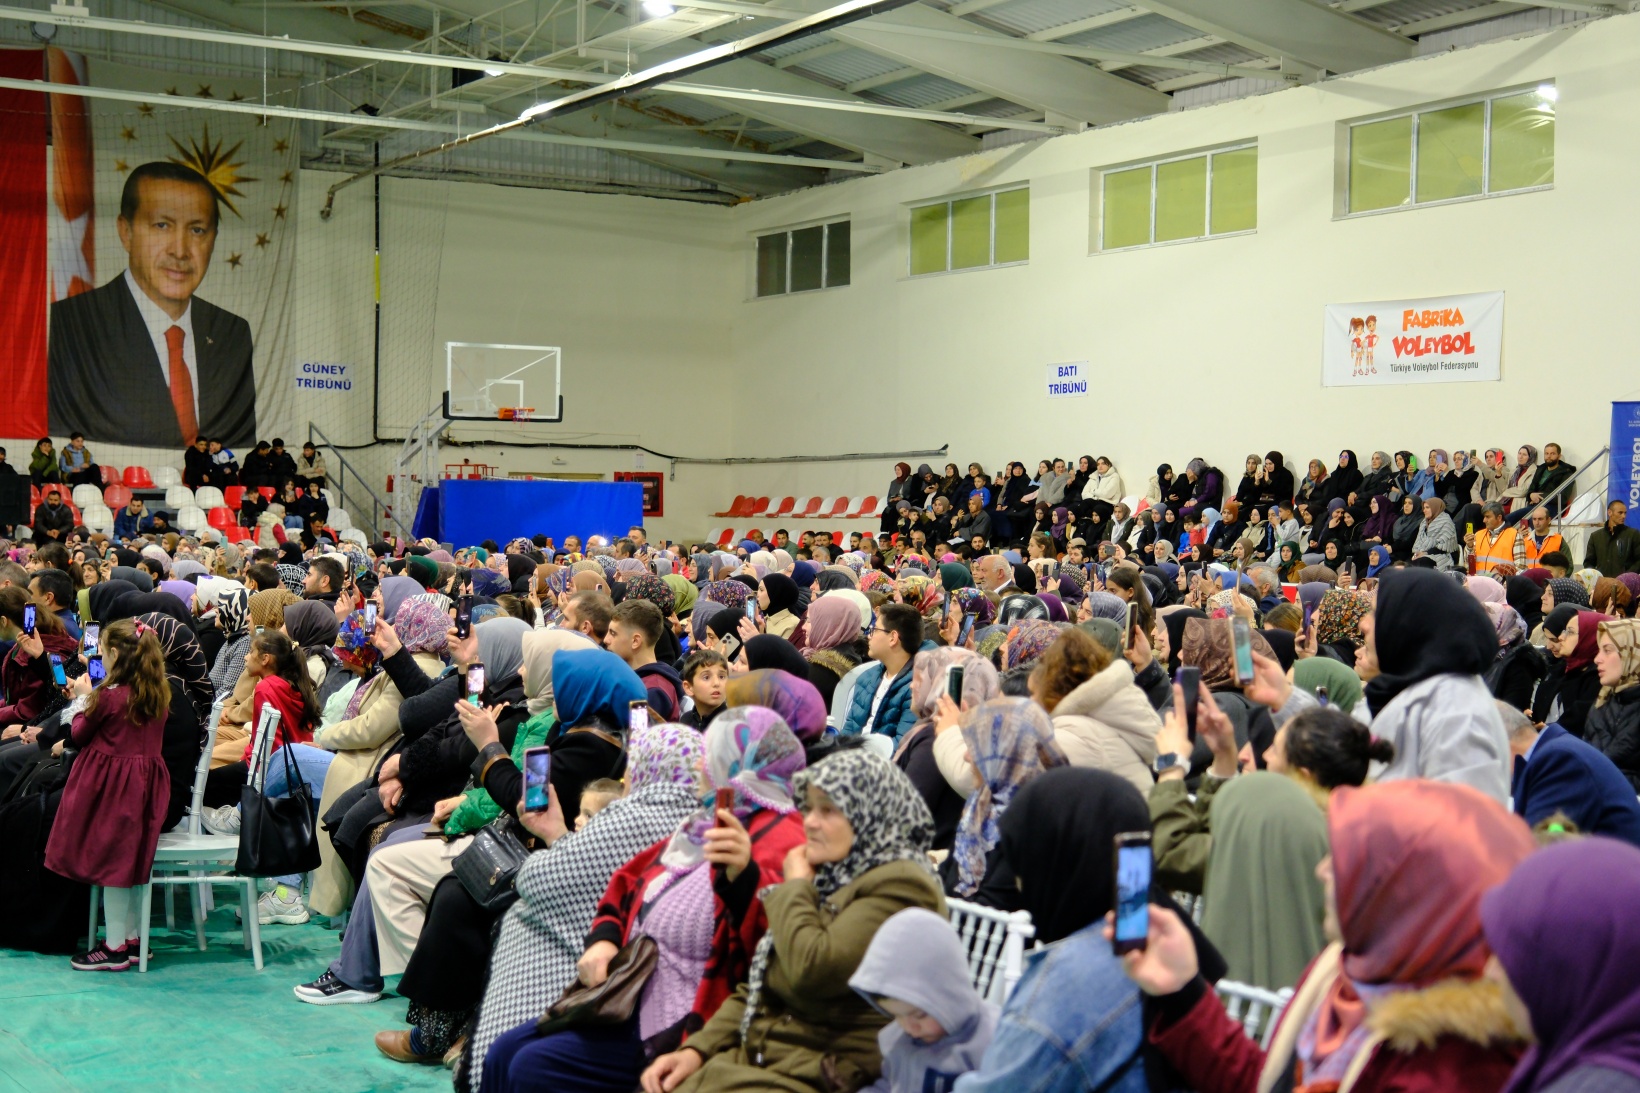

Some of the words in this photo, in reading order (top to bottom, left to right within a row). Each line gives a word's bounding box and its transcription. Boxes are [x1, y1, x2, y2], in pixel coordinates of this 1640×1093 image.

[1392, 331, 1475, 359] VOLEYBOL
[303, 362, 346, 375] GÜNEY
[1058, 365, 1077, 377] BATI
[1390, 363, 1411, 374] Türkiye
[1412, 362, 1439, 373] Voleybol
[1440, 361, 1479, 371] Federasyonu
[296, 377, 352, 391] TRİBÜNÜ
[1048, 380, 1087, 395] TRİBÜNÜ
